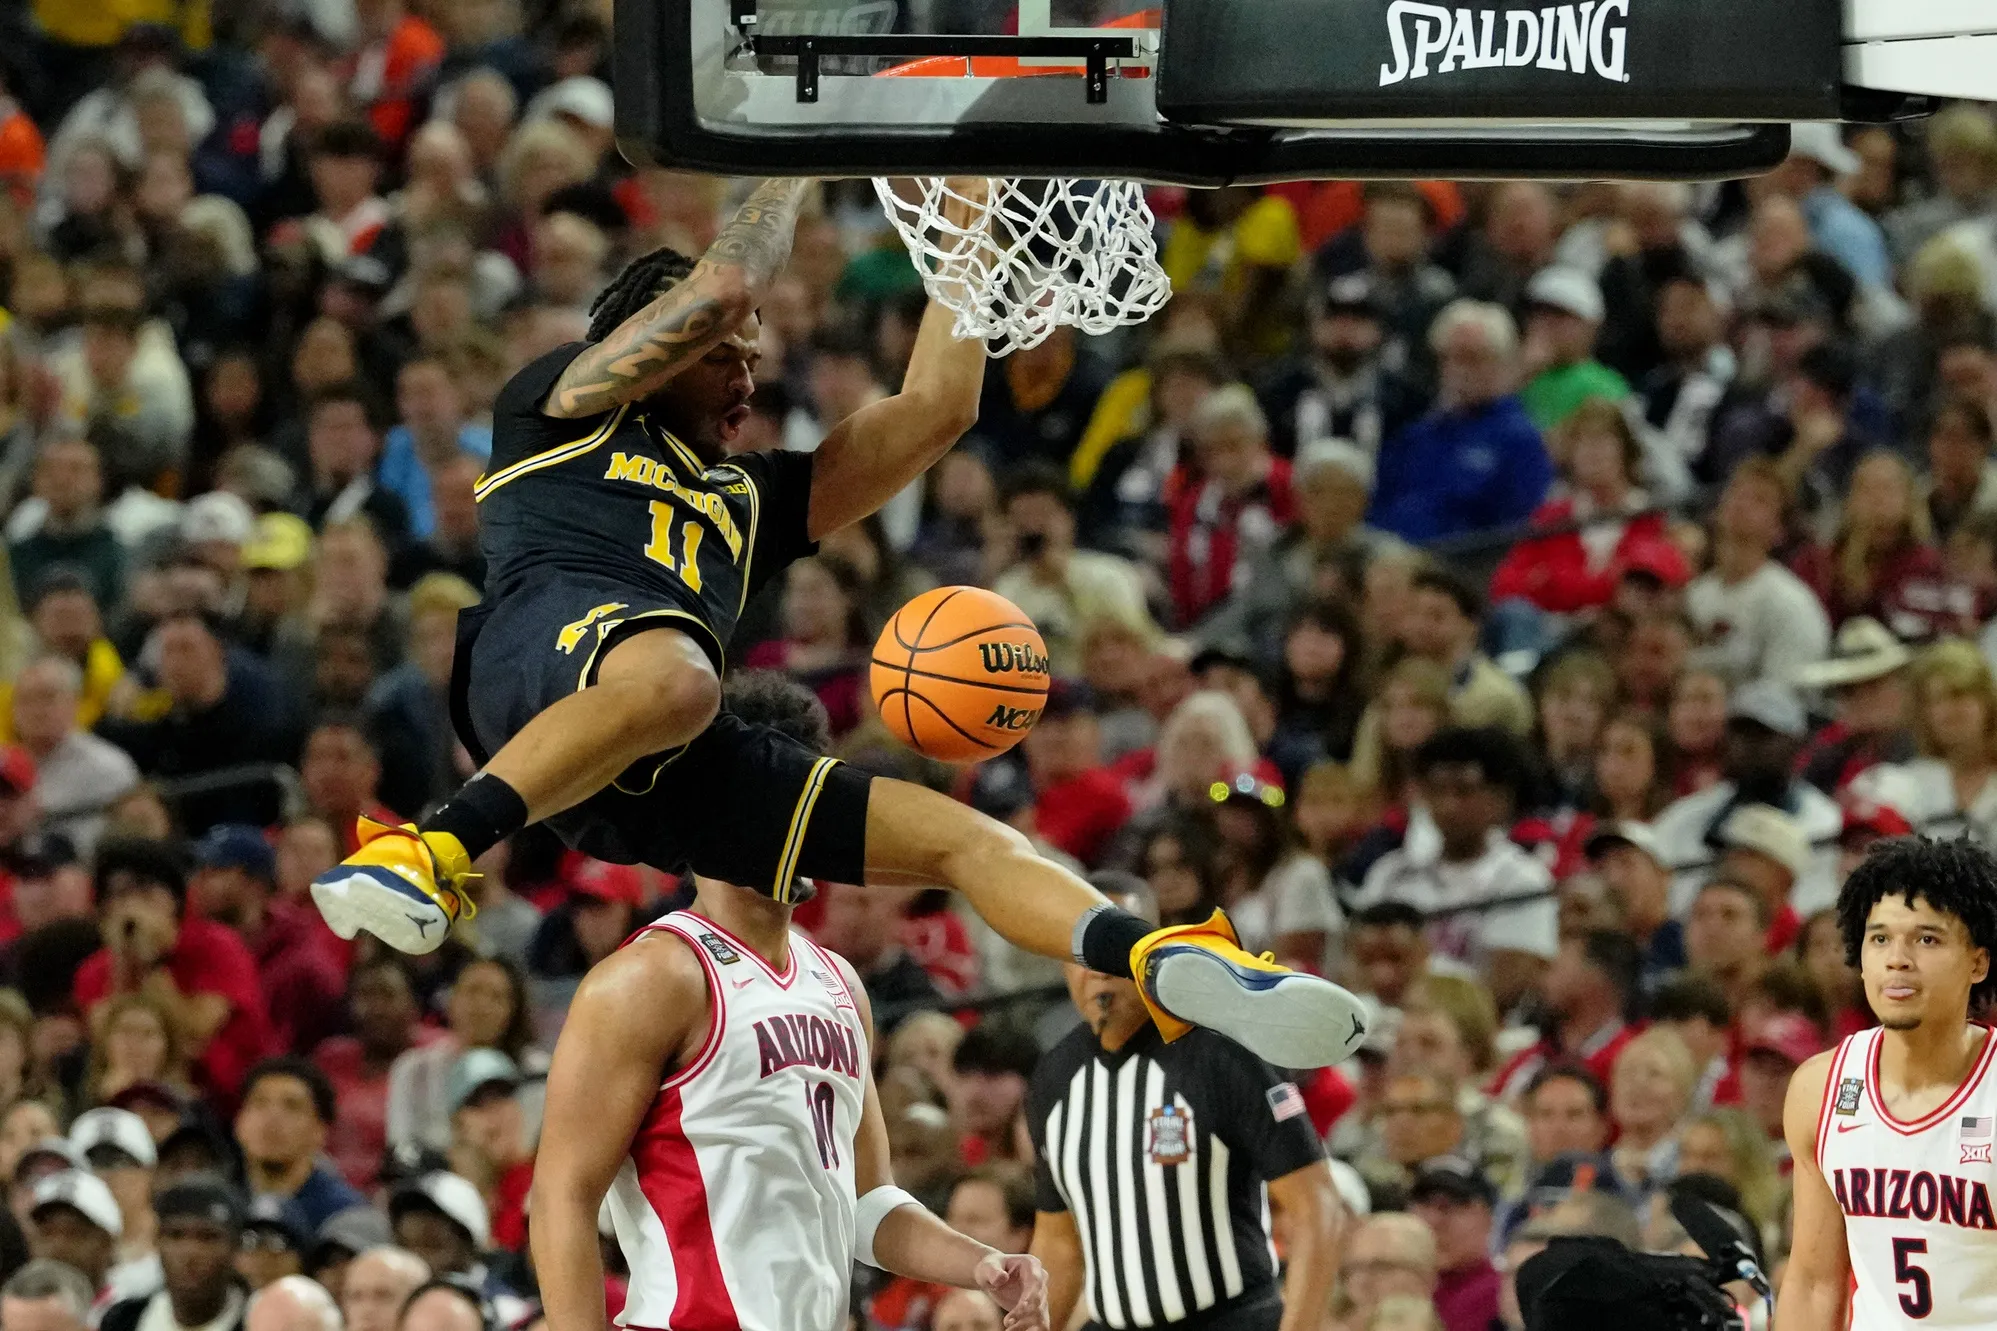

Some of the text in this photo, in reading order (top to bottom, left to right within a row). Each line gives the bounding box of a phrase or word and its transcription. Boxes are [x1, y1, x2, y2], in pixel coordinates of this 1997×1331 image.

[1379, 0, 1629, 87] SPALDING
[644, 500, 704, 594] 11
[978, 642, 1049, 673] Wilso
[752, 1013, 860, 1079] ARIZONA
[1833, 1168, 1997, 1231] ARIZONA
[1891, 1237, 1933, 1320] 5
